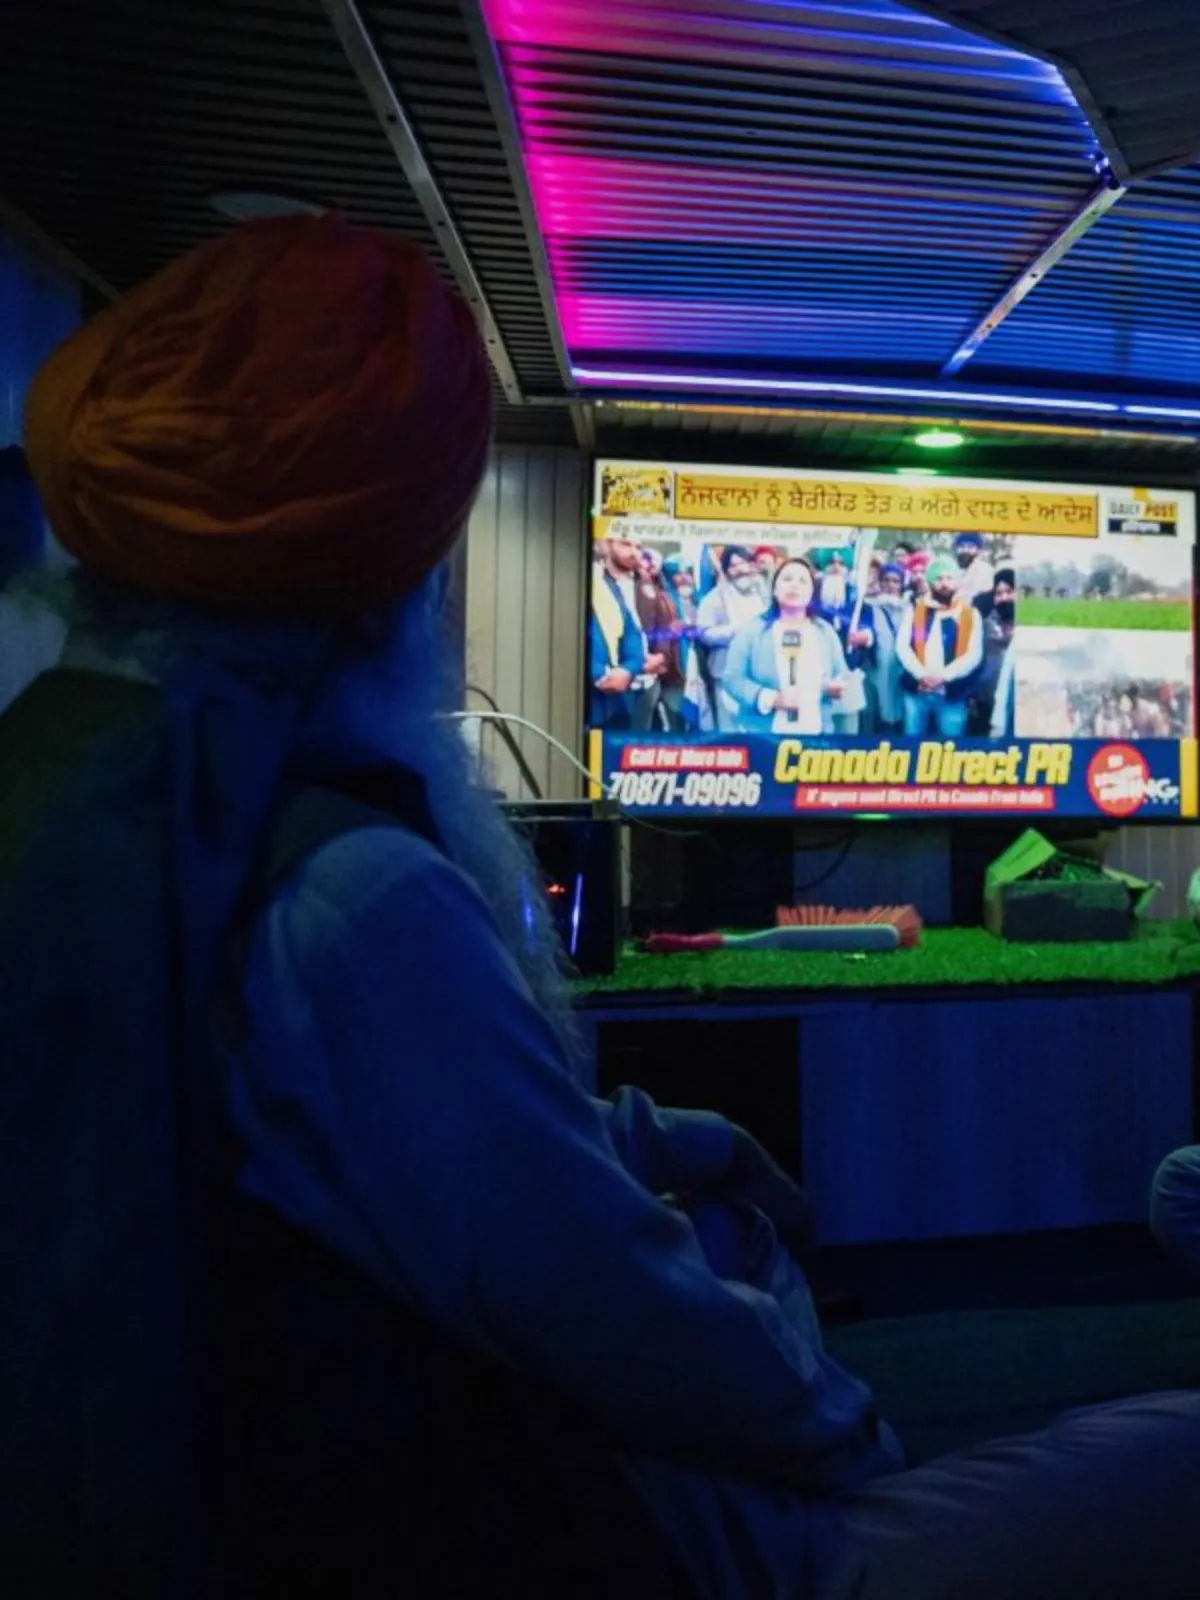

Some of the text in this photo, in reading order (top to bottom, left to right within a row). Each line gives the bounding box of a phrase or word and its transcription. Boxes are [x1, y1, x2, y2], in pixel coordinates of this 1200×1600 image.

[774, 739, 911, 783] Canada
[915, 741, 1021, 784] Direct
[1025, 743, 1073, 785] PR
